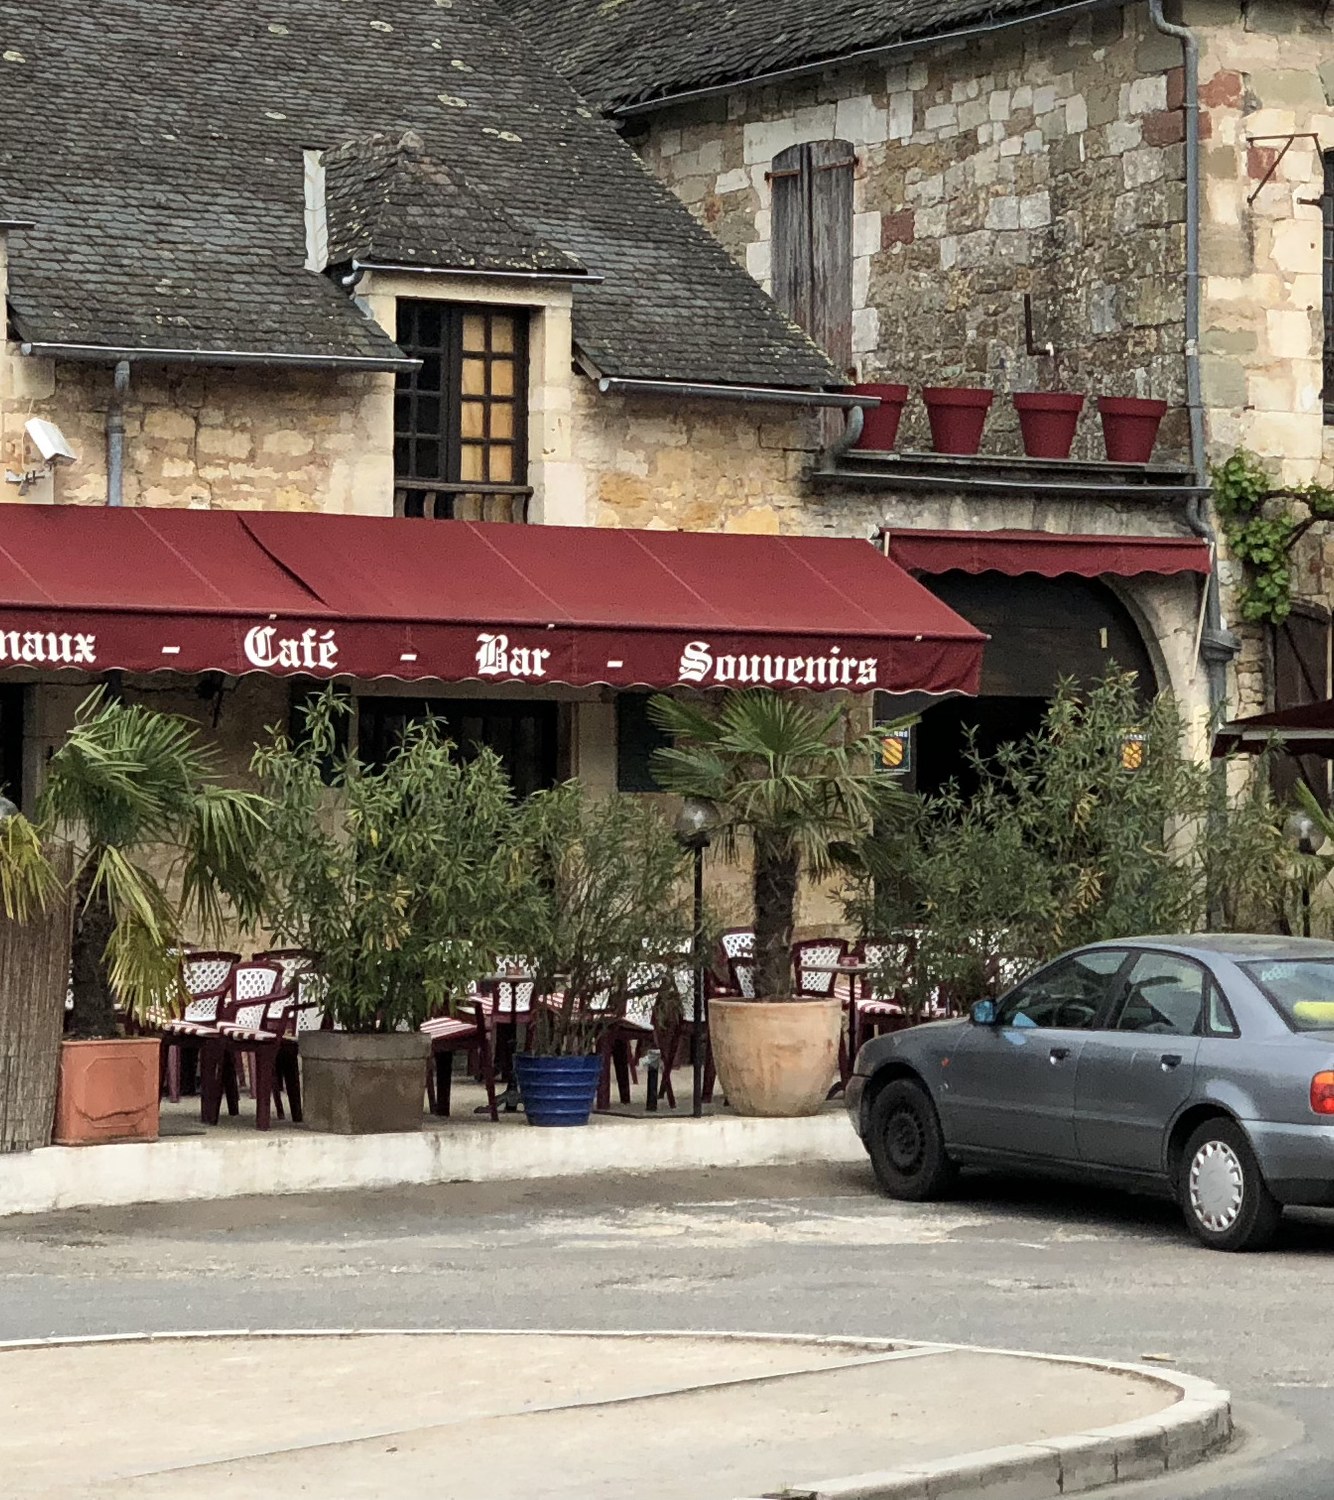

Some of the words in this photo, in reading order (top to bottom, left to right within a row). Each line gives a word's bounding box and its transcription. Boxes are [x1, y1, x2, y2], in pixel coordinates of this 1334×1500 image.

[243, 625, 339, 669] Café
[475, 633, 551, 677] Bar
[677, 641, 878, 686] Souvenirs
